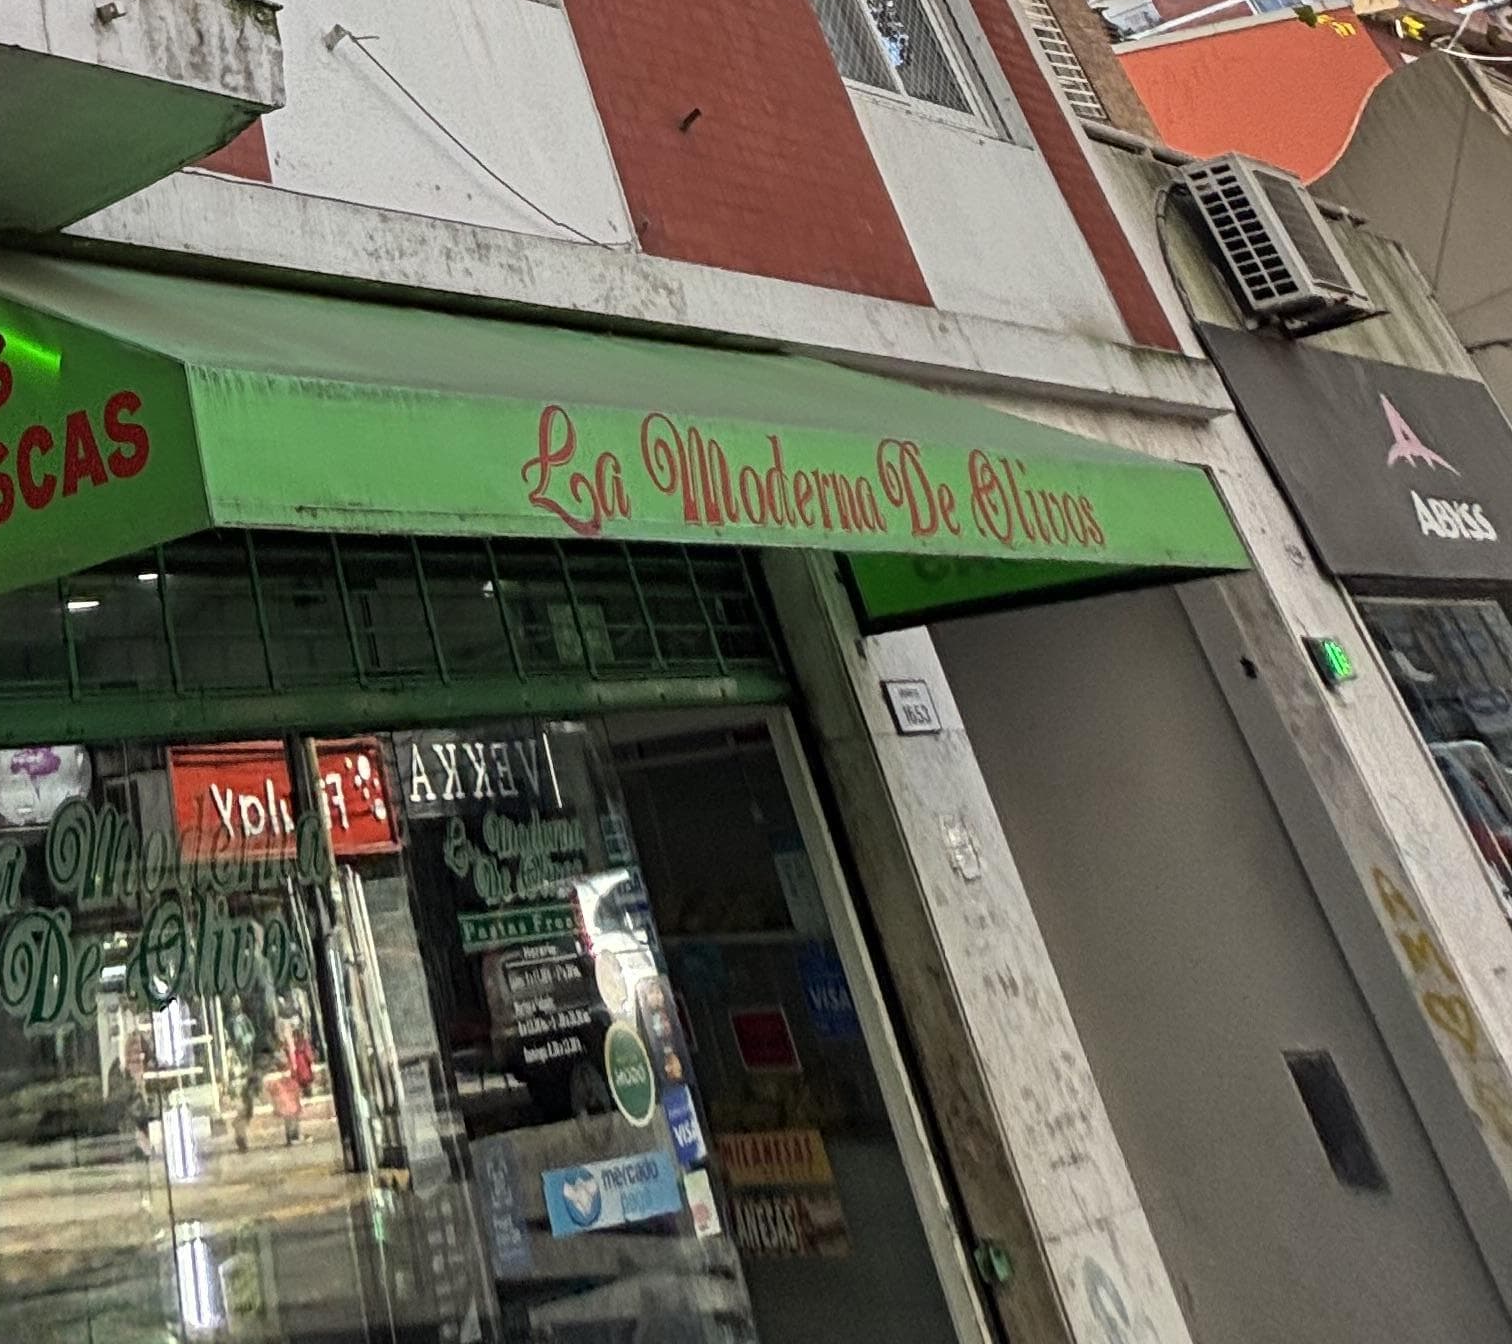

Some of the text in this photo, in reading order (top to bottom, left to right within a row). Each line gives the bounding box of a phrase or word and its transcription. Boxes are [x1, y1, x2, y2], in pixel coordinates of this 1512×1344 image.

[520, 403, 1108, 548] La Moderna De Olivos
[46, 797, 327, 904] Moderna
[0, 892, 310, 1029] De Olivos
[601, 1157, 659, 1191] mercado
